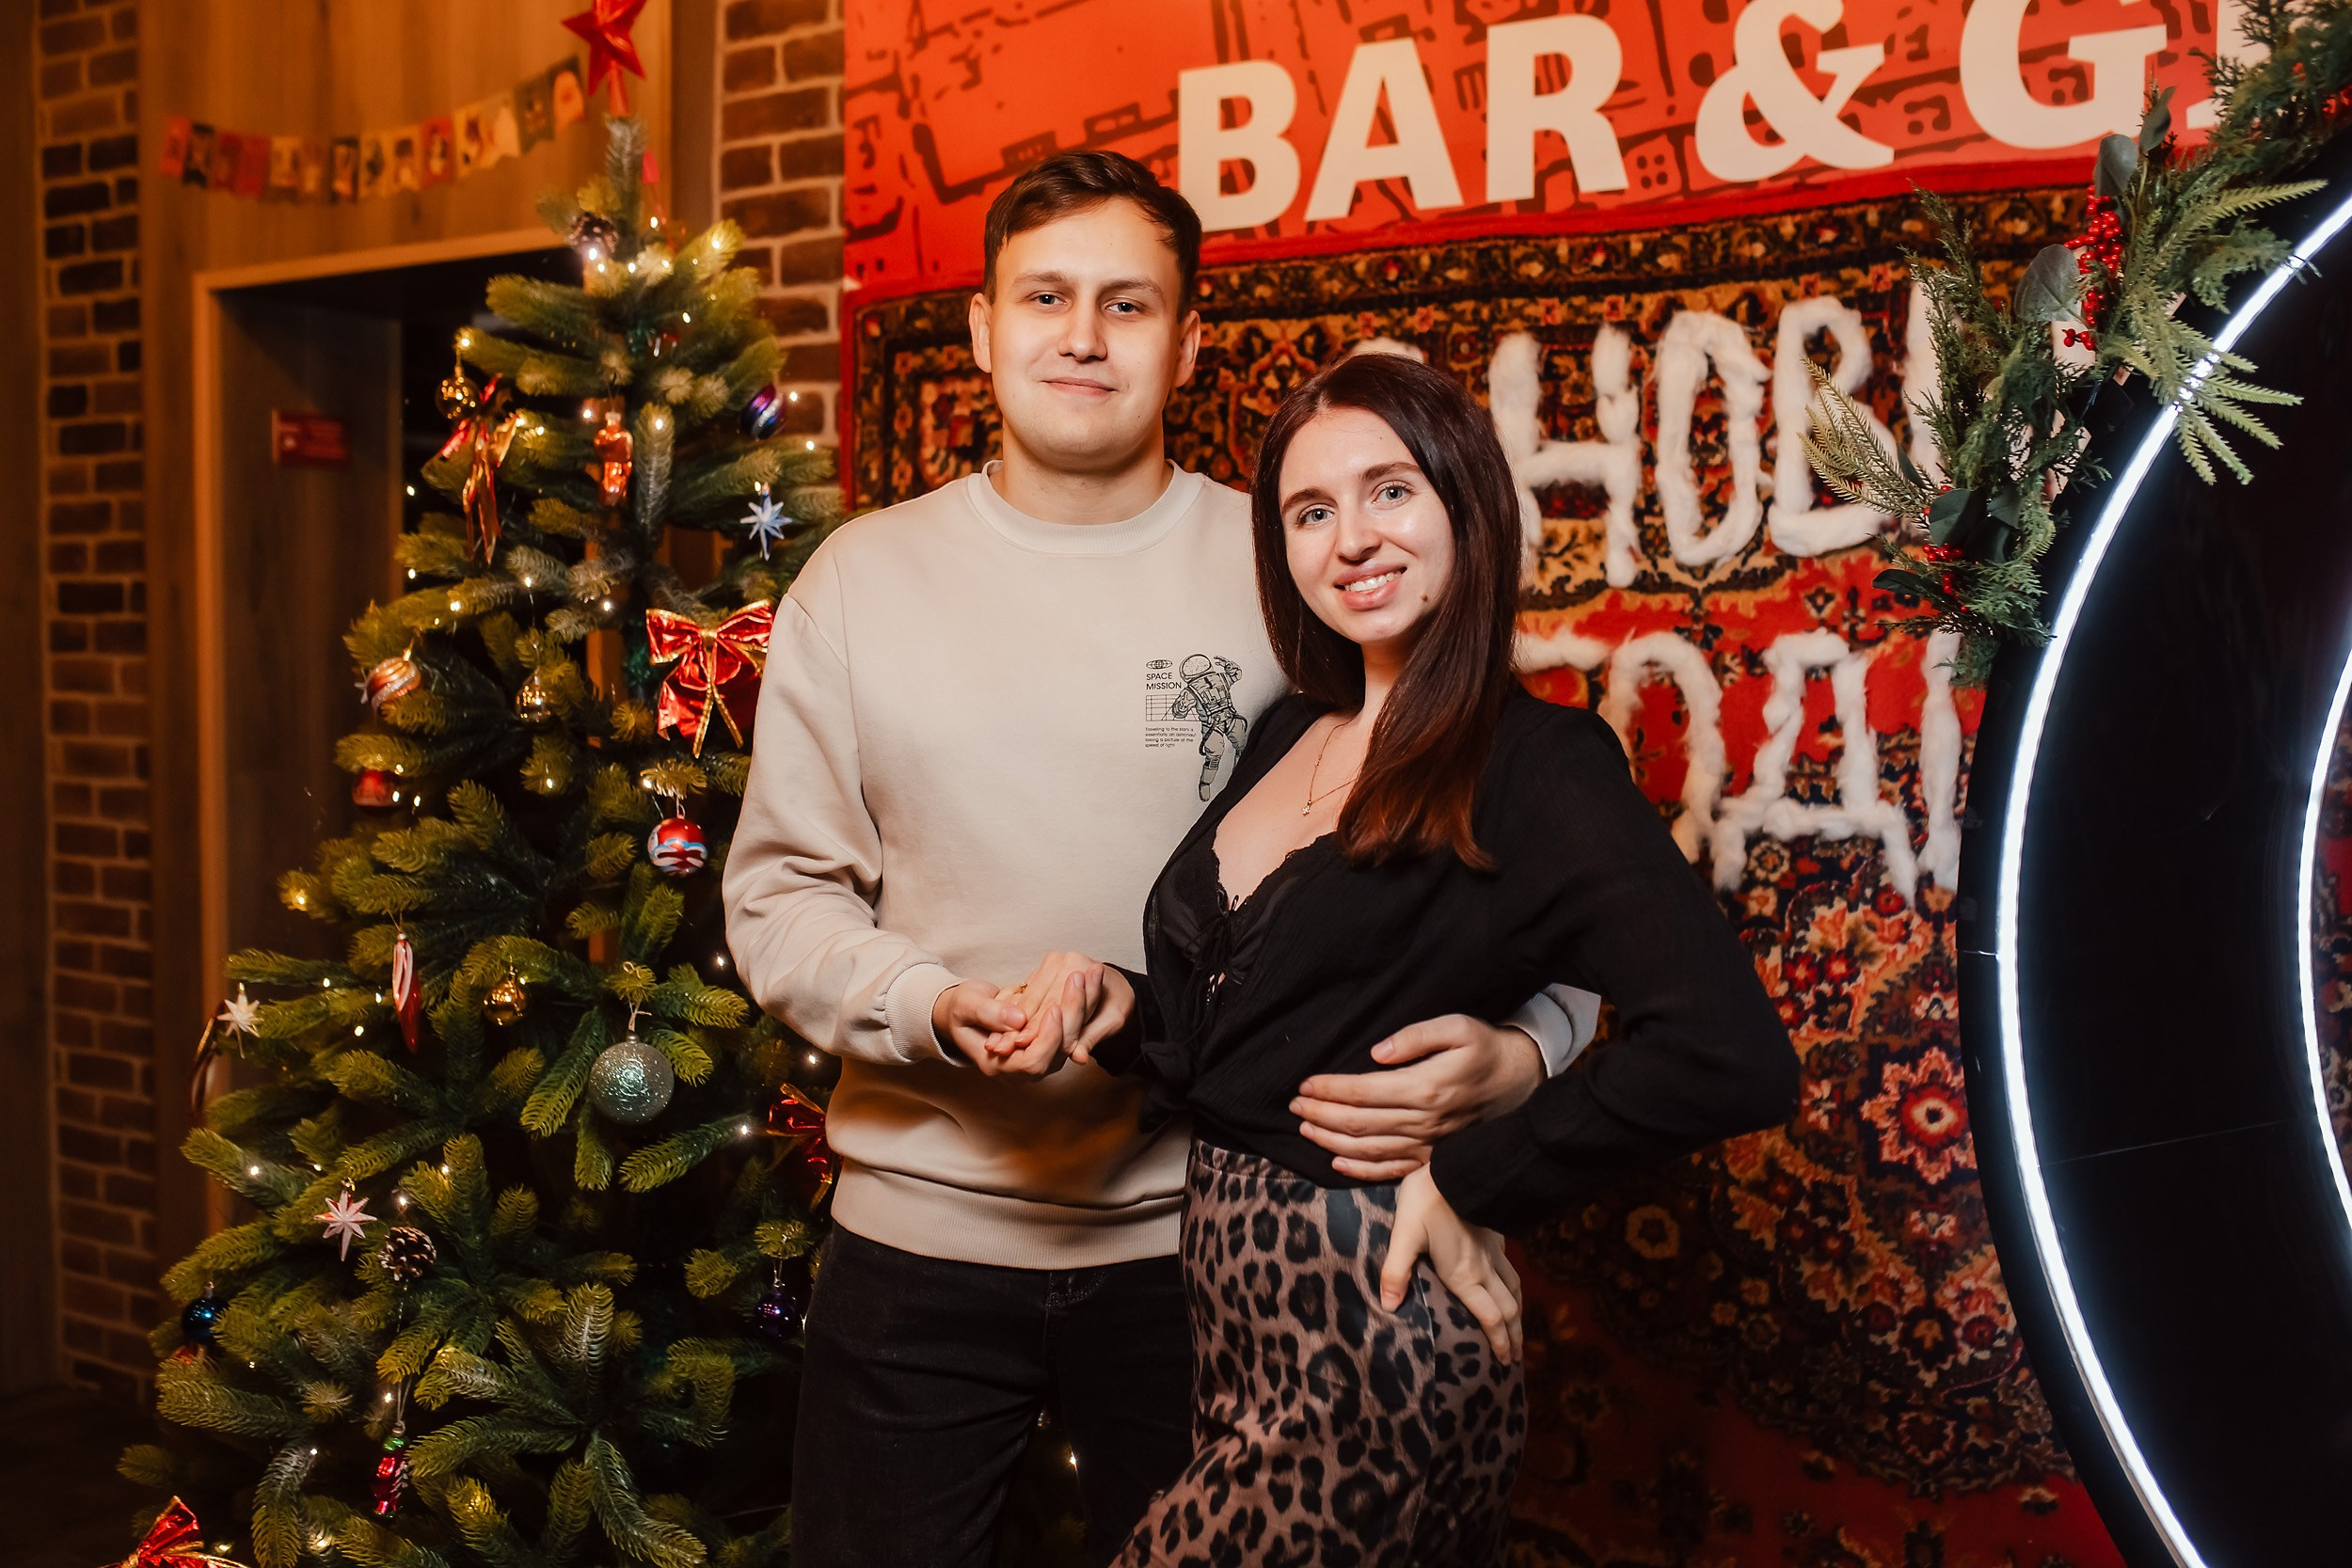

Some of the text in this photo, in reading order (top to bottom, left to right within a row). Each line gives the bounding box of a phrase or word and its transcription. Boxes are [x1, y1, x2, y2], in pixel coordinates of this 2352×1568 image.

[1178, 13, 1629, 233] BAR
[1698, 0, 1894, 182] &
[1488, 282, 2091, 589] НОВ
[1146, 672, 1172, 681] SPACE
[1146, 682, 1182, 690] MISSION
